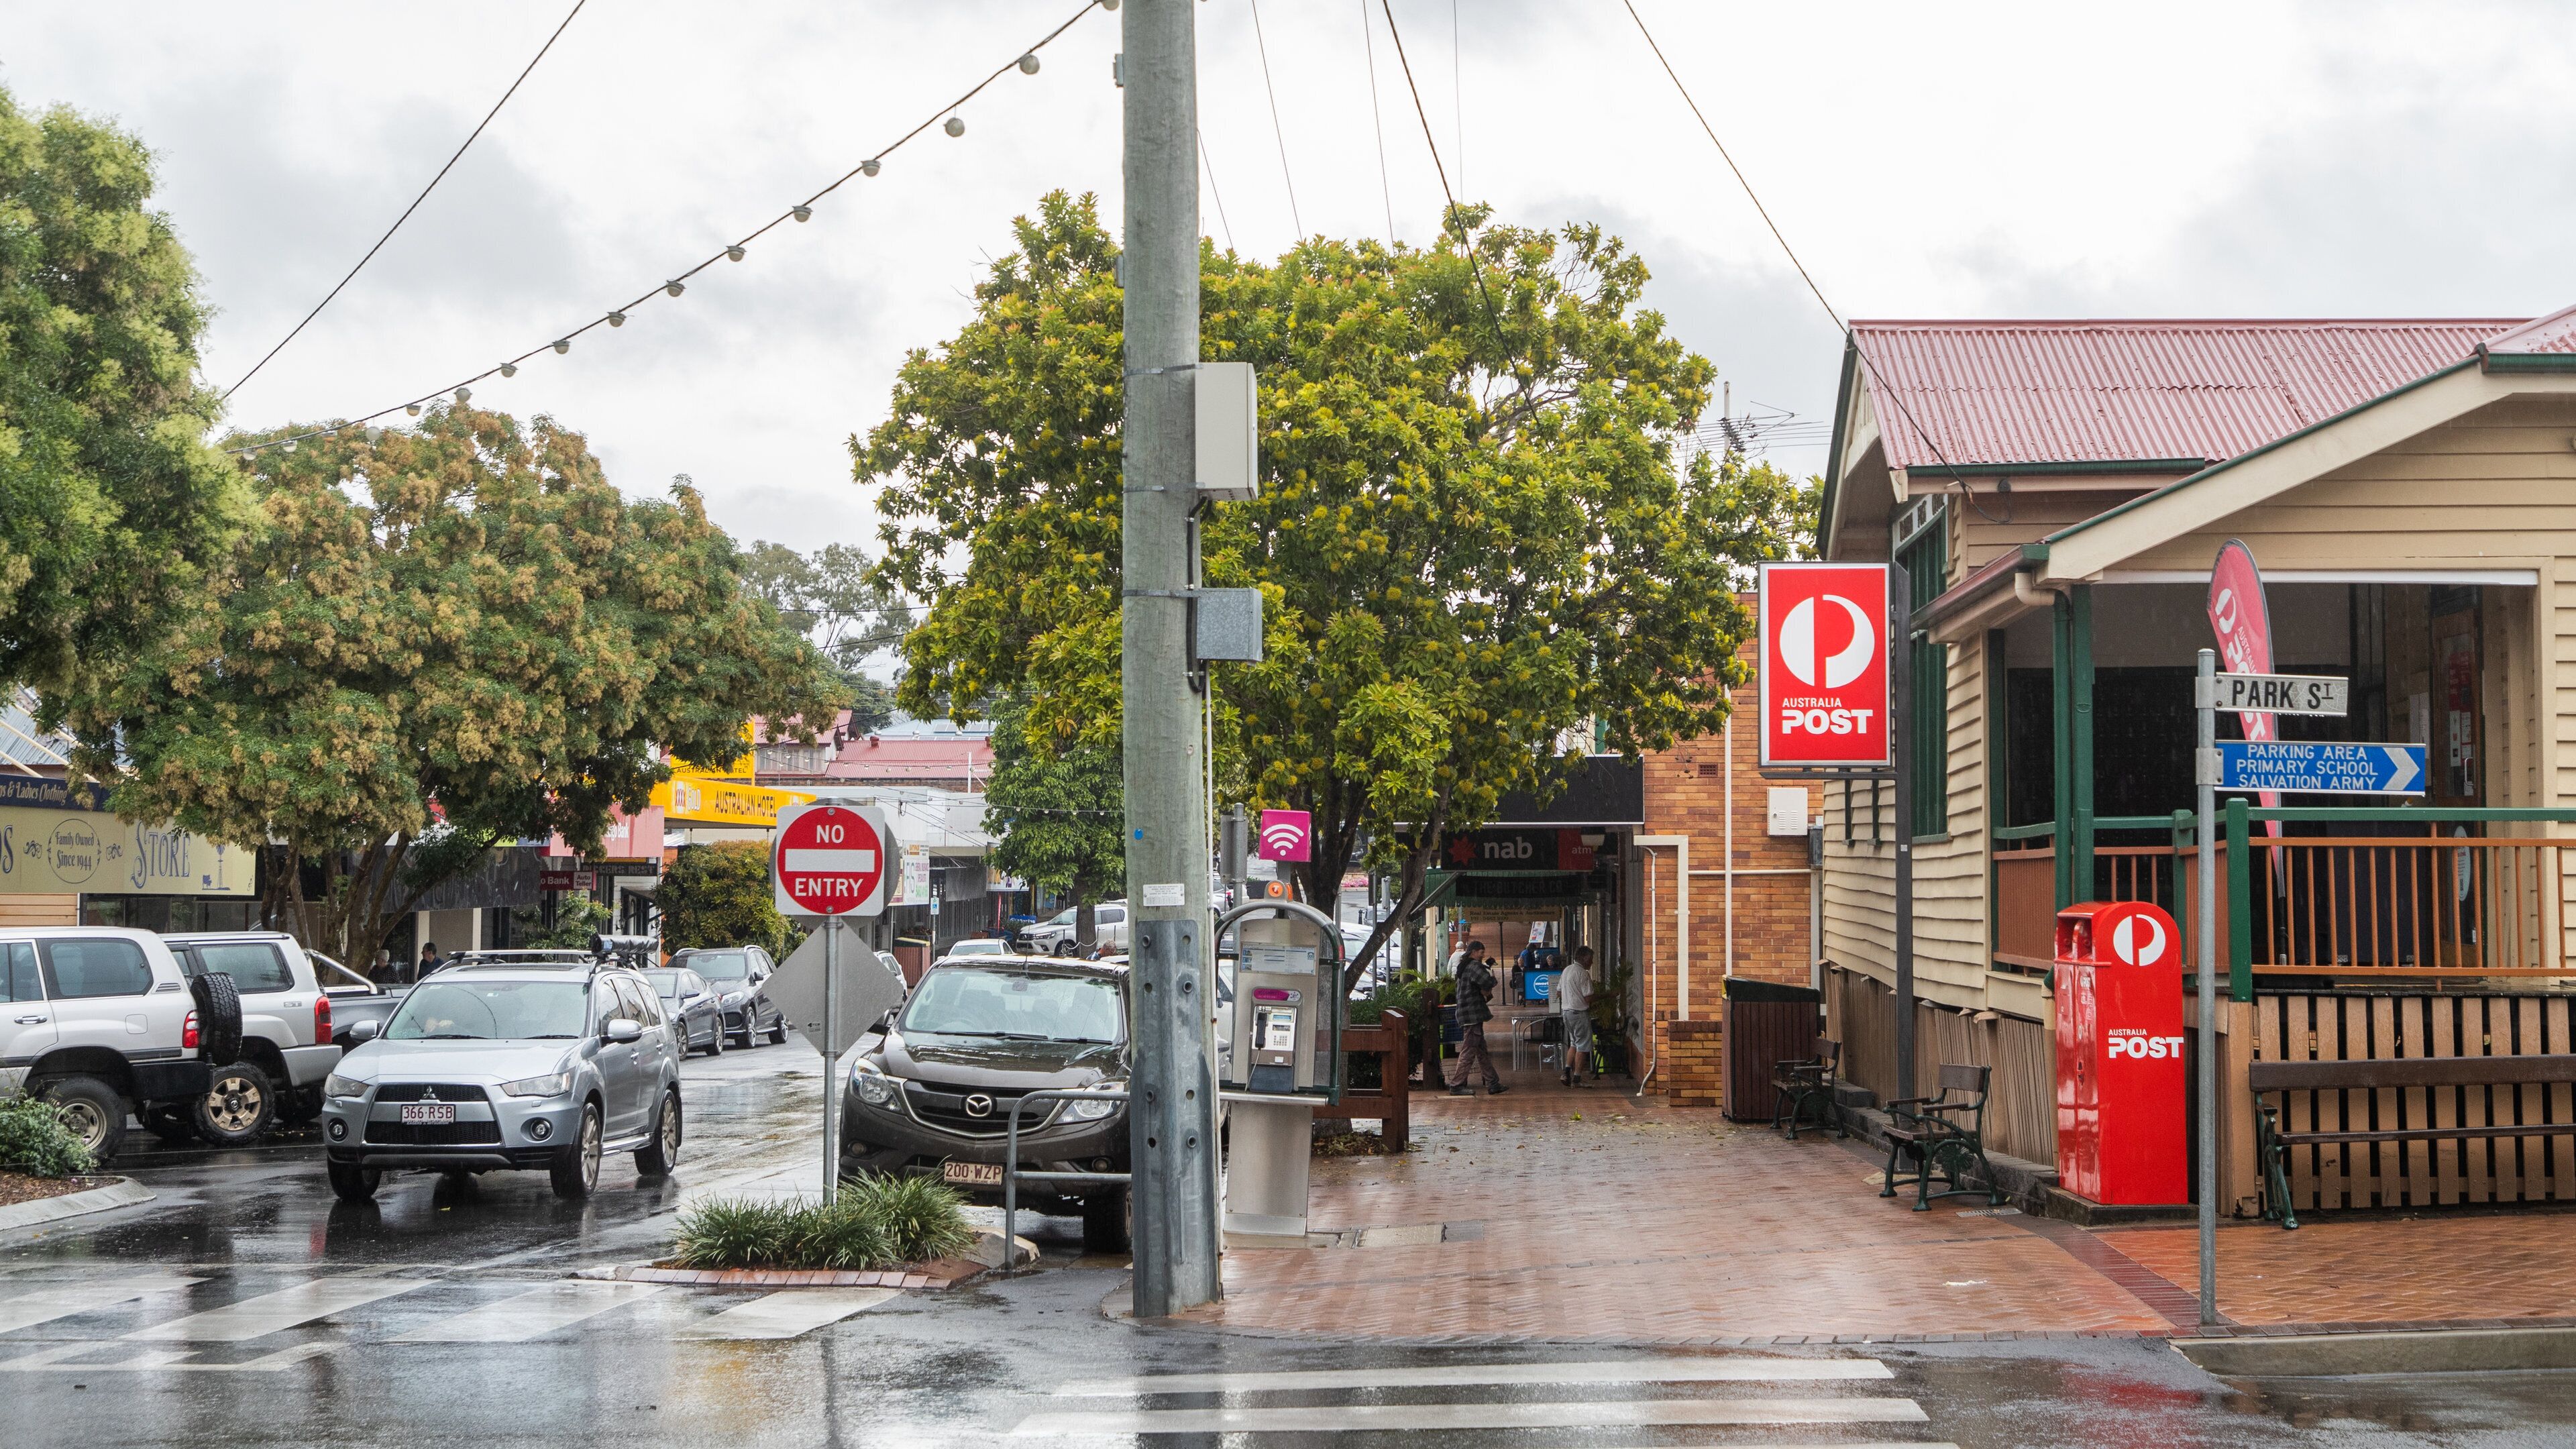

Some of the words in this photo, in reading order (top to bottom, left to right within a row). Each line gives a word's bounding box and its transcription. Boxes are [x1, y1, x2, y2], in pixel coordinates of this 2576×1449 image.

[1782, 698, 1842, 708] AUSTRALIA
[2232, 680, 2294, 708] PARK
[1782, 708, 1873, 735] POST
[2247, 744, 2314, 759] PARKING
[2322, 746, 2367, 761] AREA
[2236, 759, 2307, 774] PRIMARY
[2316, 761, 2379, 776] SCHOOL
[2238, 773, 2322, 790] SALVATION
[2329, 776, 2376, 791] ARMY
[7, 781, 14, 797] &
[16, 782, 39, 799] Ladies
[39, 784, 68, 806] Clothing
[687, 786, 701, 812] GOLD
[714, 791, 755, 816] AUSTRALIAN
[757, 796, 777, 818] HOTEL
[617, 822, 629, 839] Bank
[816, 824, 845, 844] NO
[56, 832, 74, 849] Family
[75, 833, 94, 847] Owned
[1483, 837, 1533, 859] nab
[1572, 846, 1592, 855] atm
[57, 849, 76, 869] Since
[77, 855, 92, 871] 1944
[547, 876, 570, 885] Bank
[795, 878, 863, 897] ENTRY
[1497, 880, 1546, 894] BUTCHER
[2108, 1036, 2184, 1059] POST
